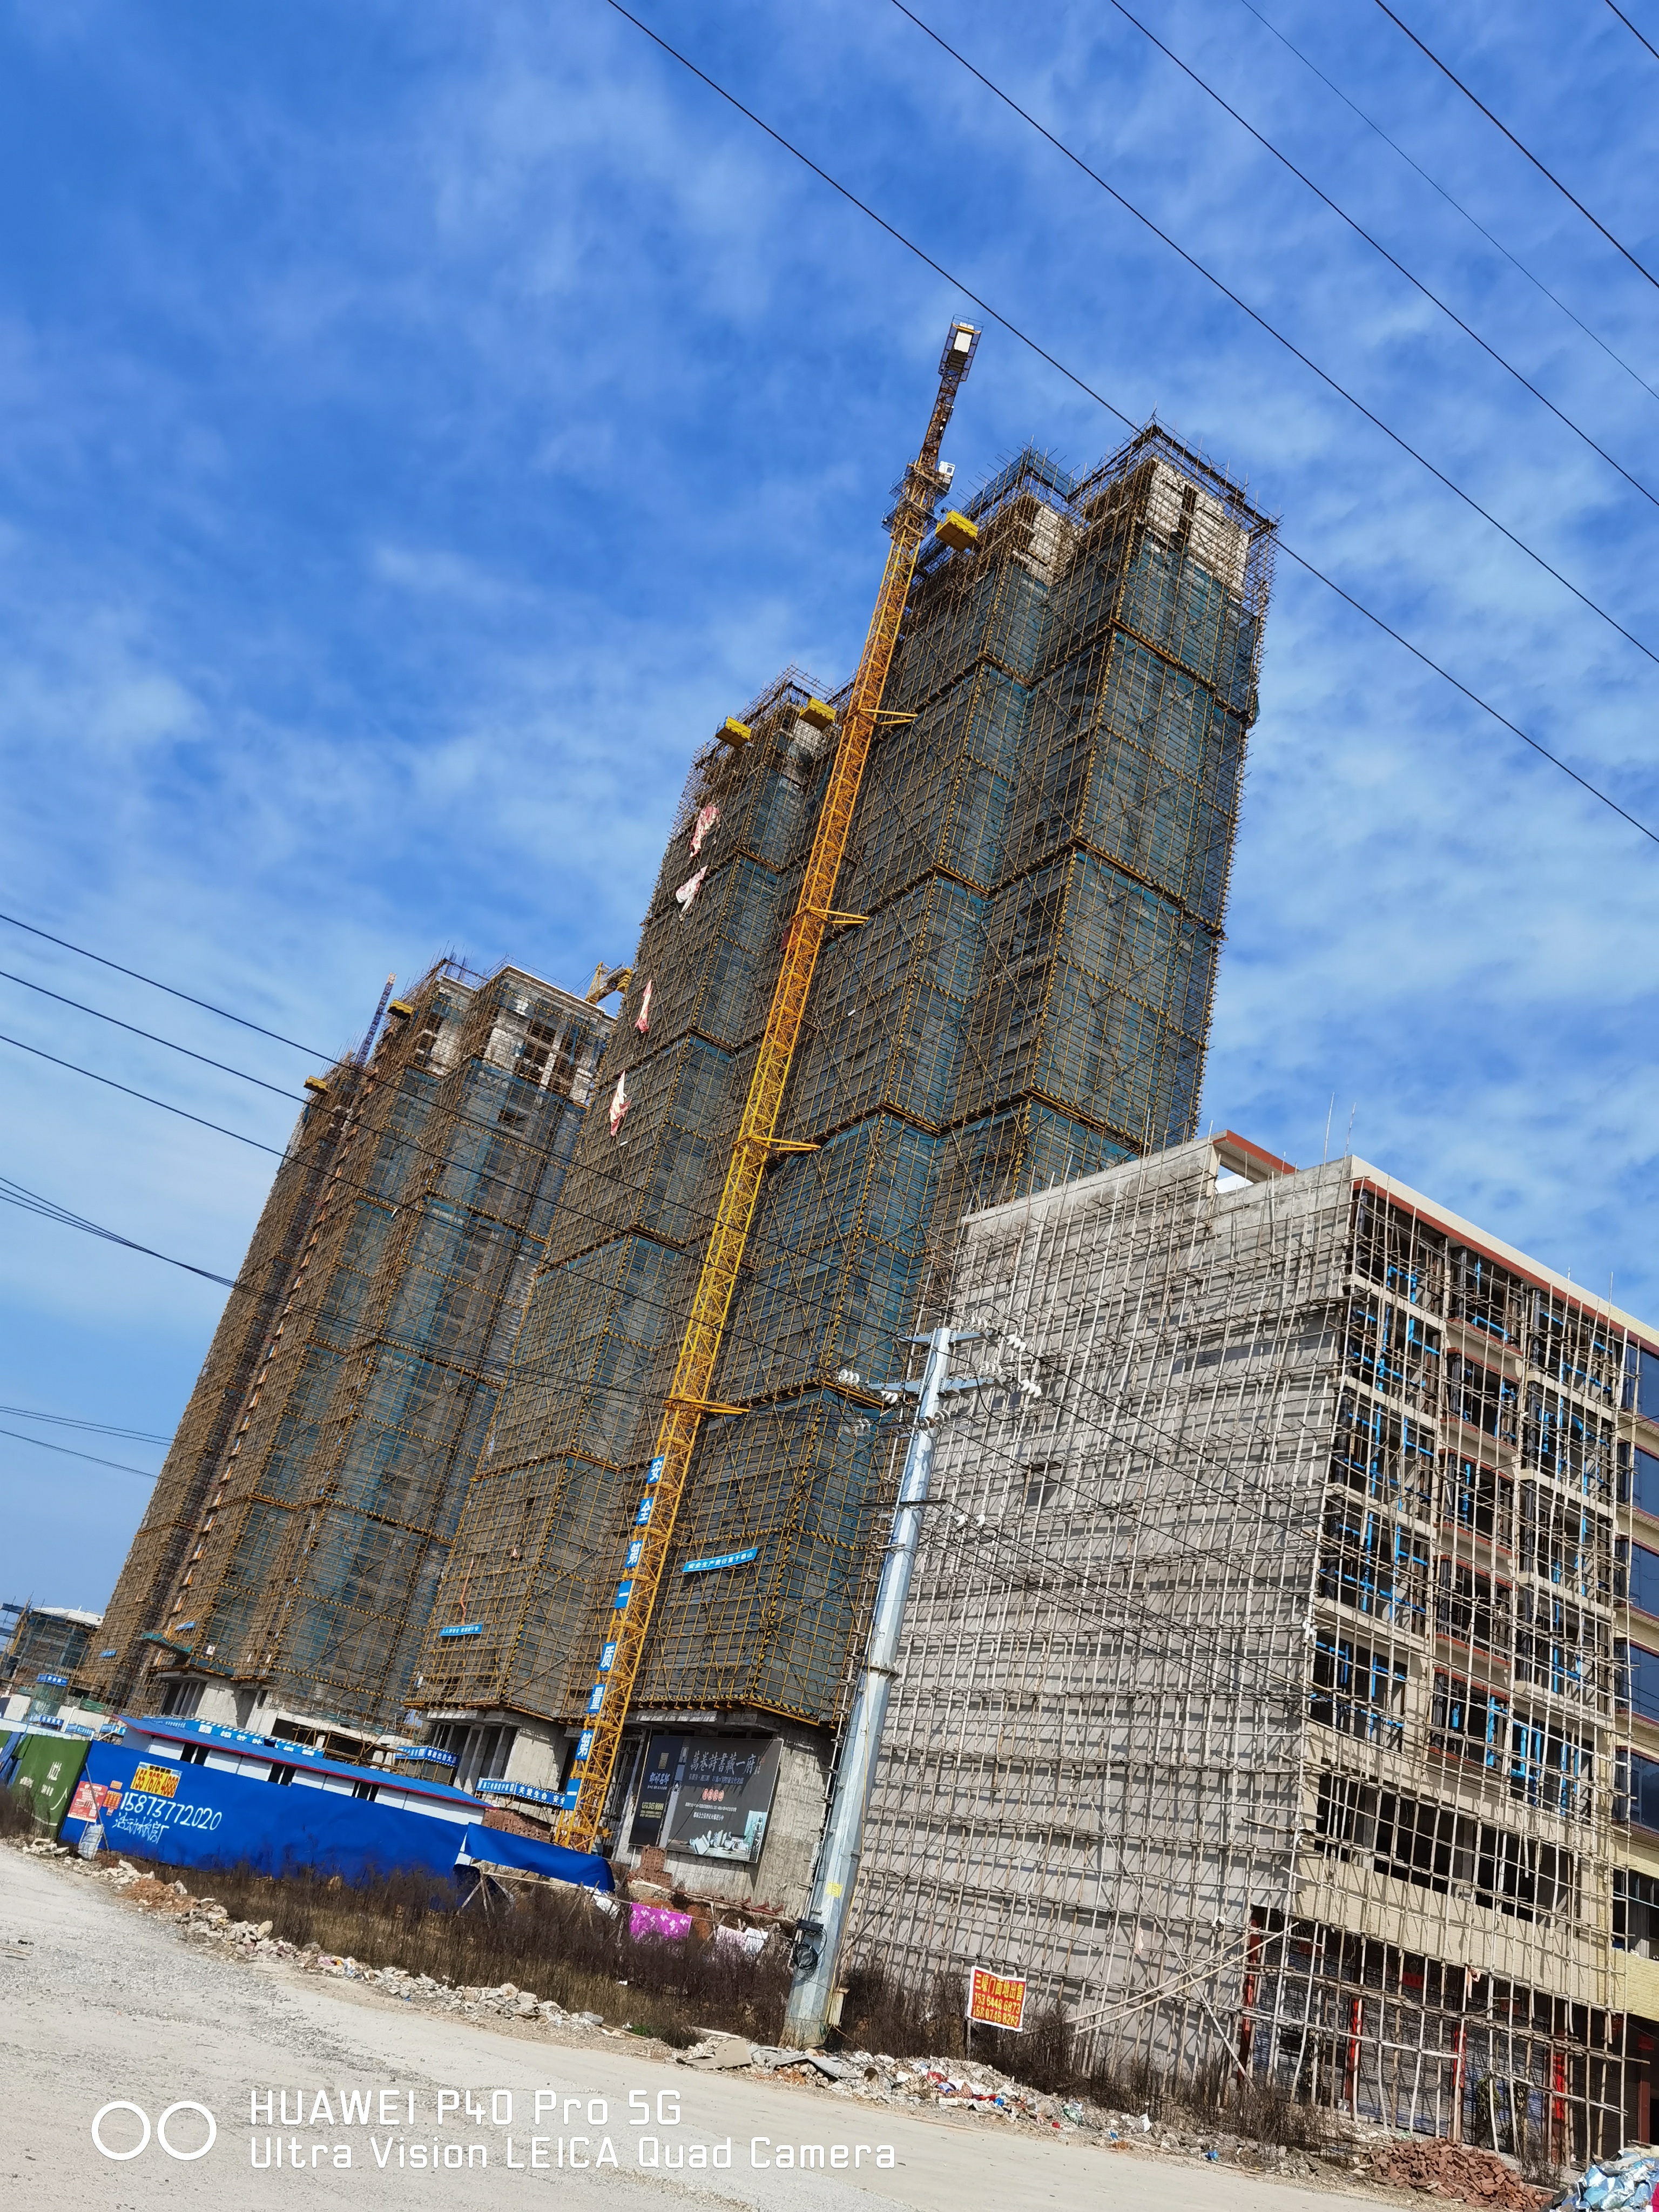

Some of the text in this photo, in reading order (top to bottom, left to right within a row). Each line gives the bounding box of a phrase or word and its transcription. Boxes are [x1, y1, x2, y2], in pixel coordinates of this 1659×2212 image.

[687, 1550, 754, 1570] 安全生产责任重于泰山
[131, 1768, 147, 1789] 155
[144, 1771, 163, 1793] 7676
[160, 1775, 179, 1797] 4888
[518, 1785, 548, 1801] 关爱生命
[120, 1792, 222, 1831] 15873772020
[974, 1992, 1021, 2014] 153 6448 6873
[973, 2005, 984, 2018] 158
[985, 2007, 1002, 2023] 0746
